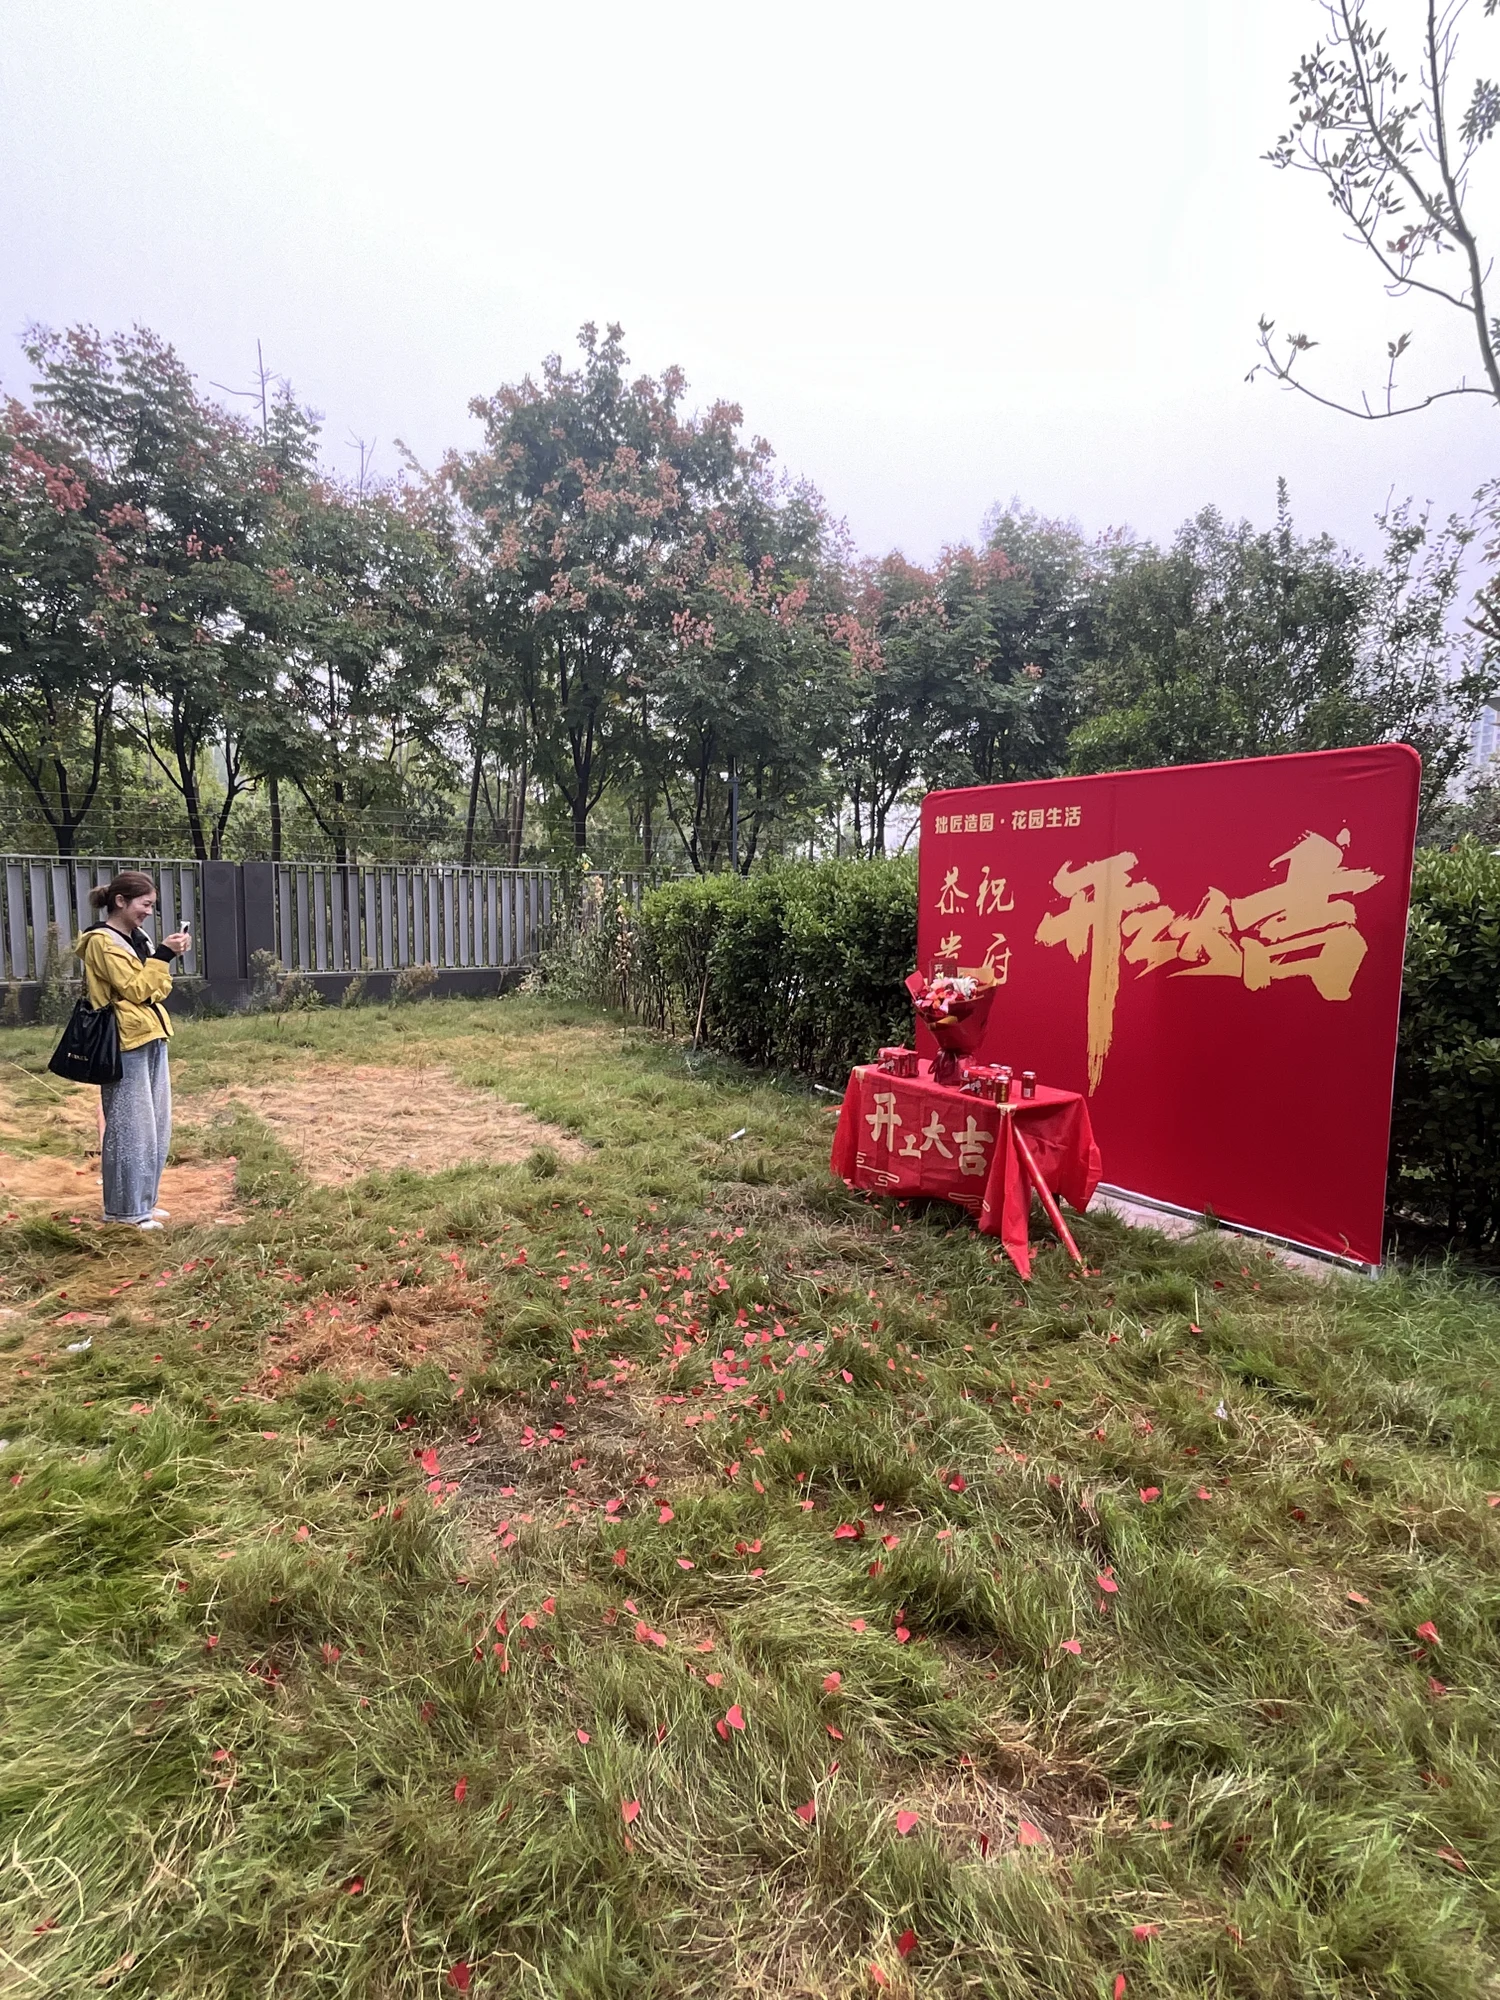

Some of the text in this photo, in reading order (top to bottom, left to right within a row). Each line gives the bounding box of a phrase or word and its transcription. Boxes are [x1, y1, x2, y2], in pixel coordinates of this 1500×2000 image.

[934, 866, 1014, 916] 恭祝
[1035, 828, 1386, 1097] 开工大吉
[864, 1092, 994, 1176] 开工大吉
